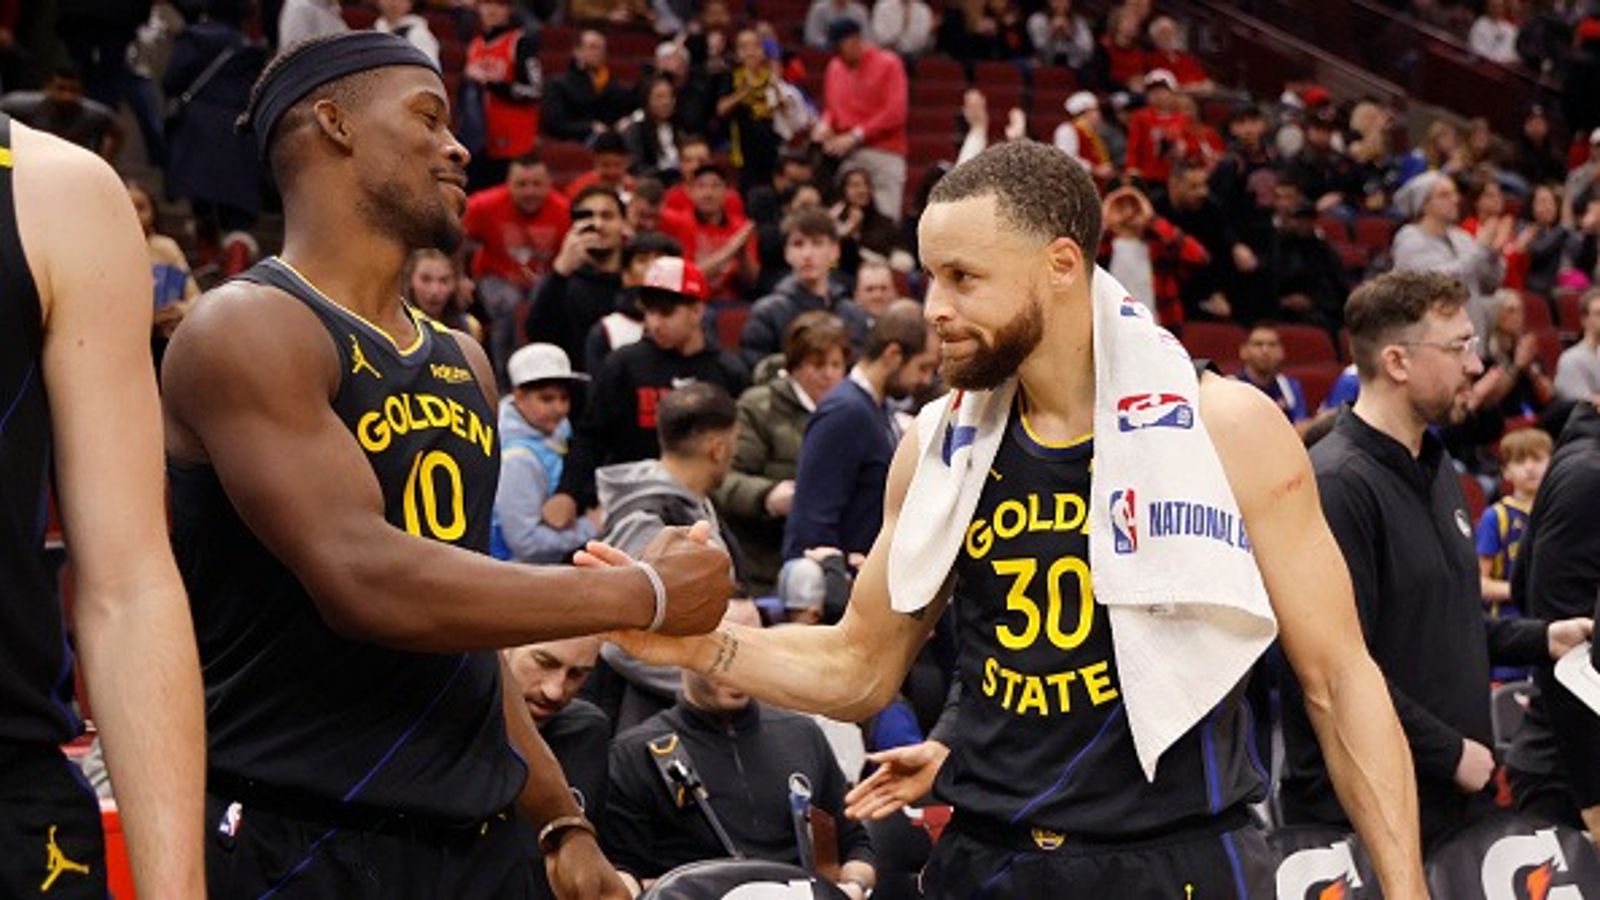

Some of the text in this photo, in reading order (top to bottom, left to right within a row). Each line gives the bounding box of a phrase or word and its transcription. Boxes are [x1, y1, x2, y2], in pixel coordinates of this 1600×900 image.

[357, 393, 493, 457] GOLDEN
[403, 450, 466, 541] 10
[966, 492, 1089, 558] GOLD
[1149, 501, 1234, 547] NATIONAL
[991, 556, 1095, 649] 30
[982, 657, 1118, 715] STATE
